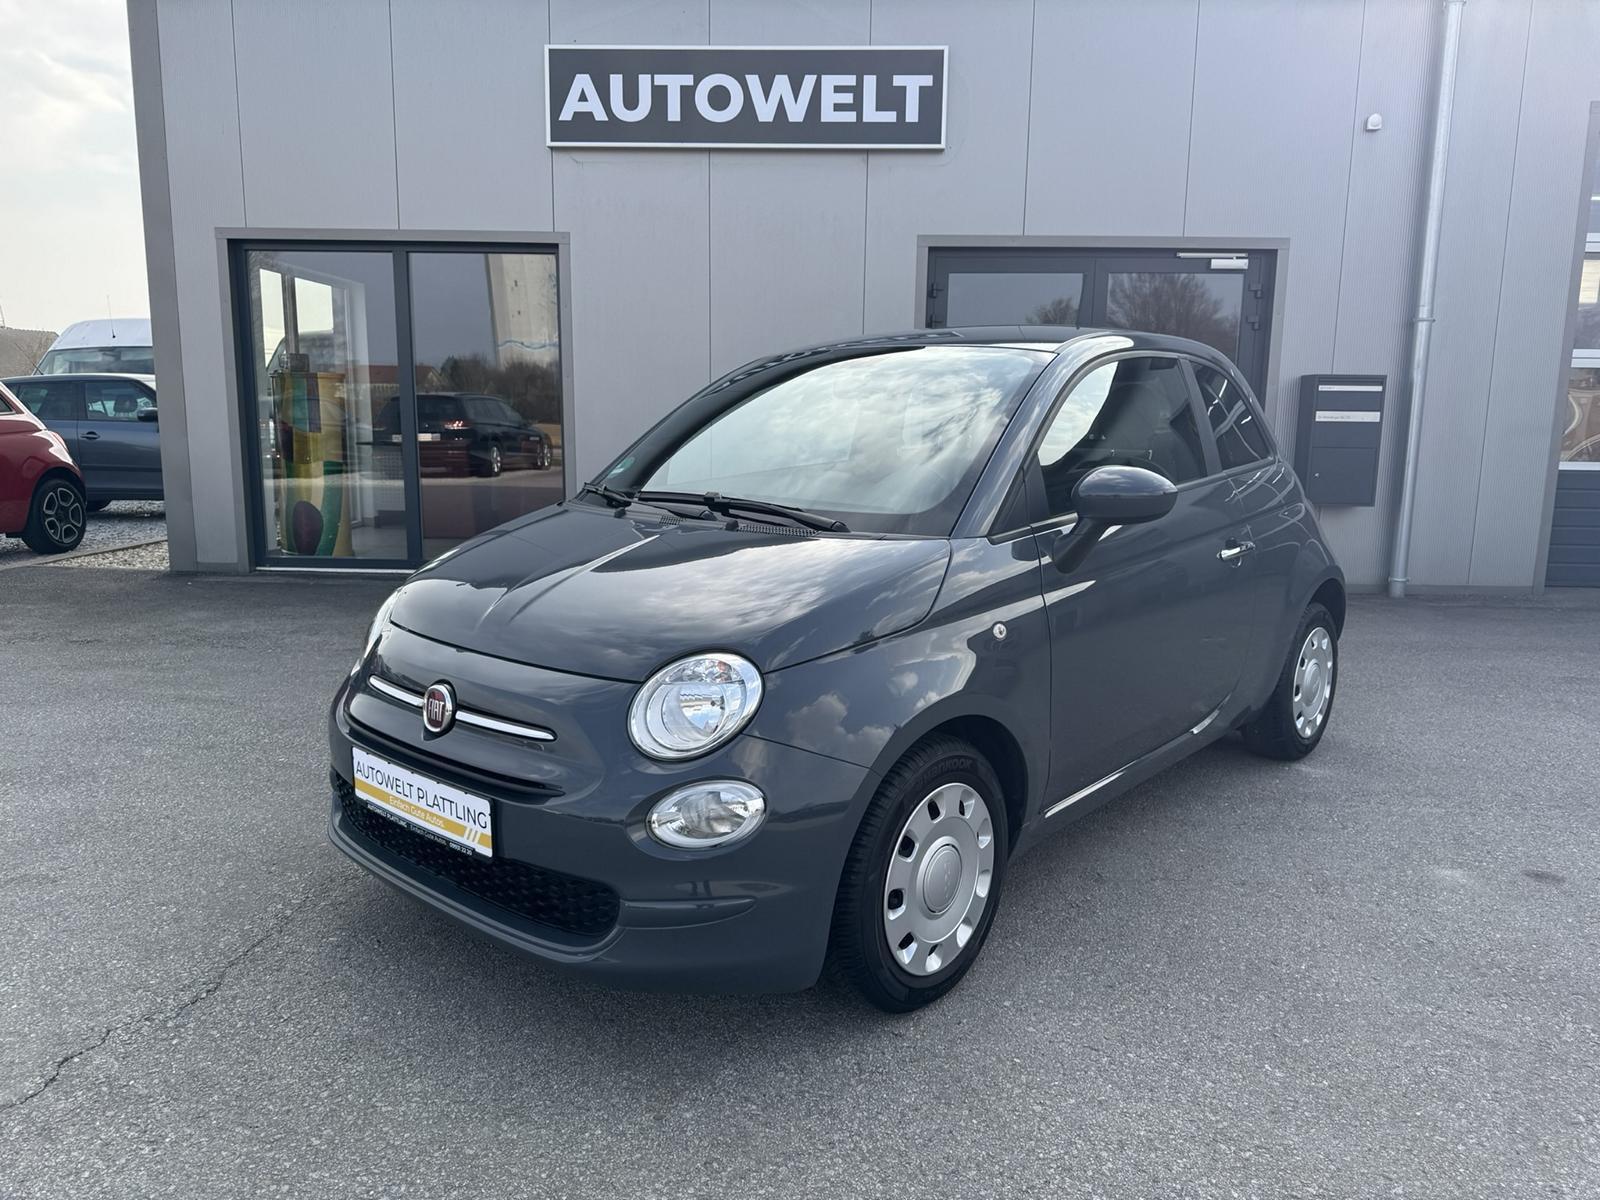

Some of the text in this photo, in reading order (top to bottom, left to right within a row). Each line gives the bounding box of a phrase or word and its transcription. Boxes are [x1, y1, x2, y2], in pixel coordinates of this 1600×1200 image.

[558, 73, 934, 123] AUTOWELT
[427, 697, 445, 722] FIAT
[355, 760, 488, 829] AUTOWELT PLATTLING
